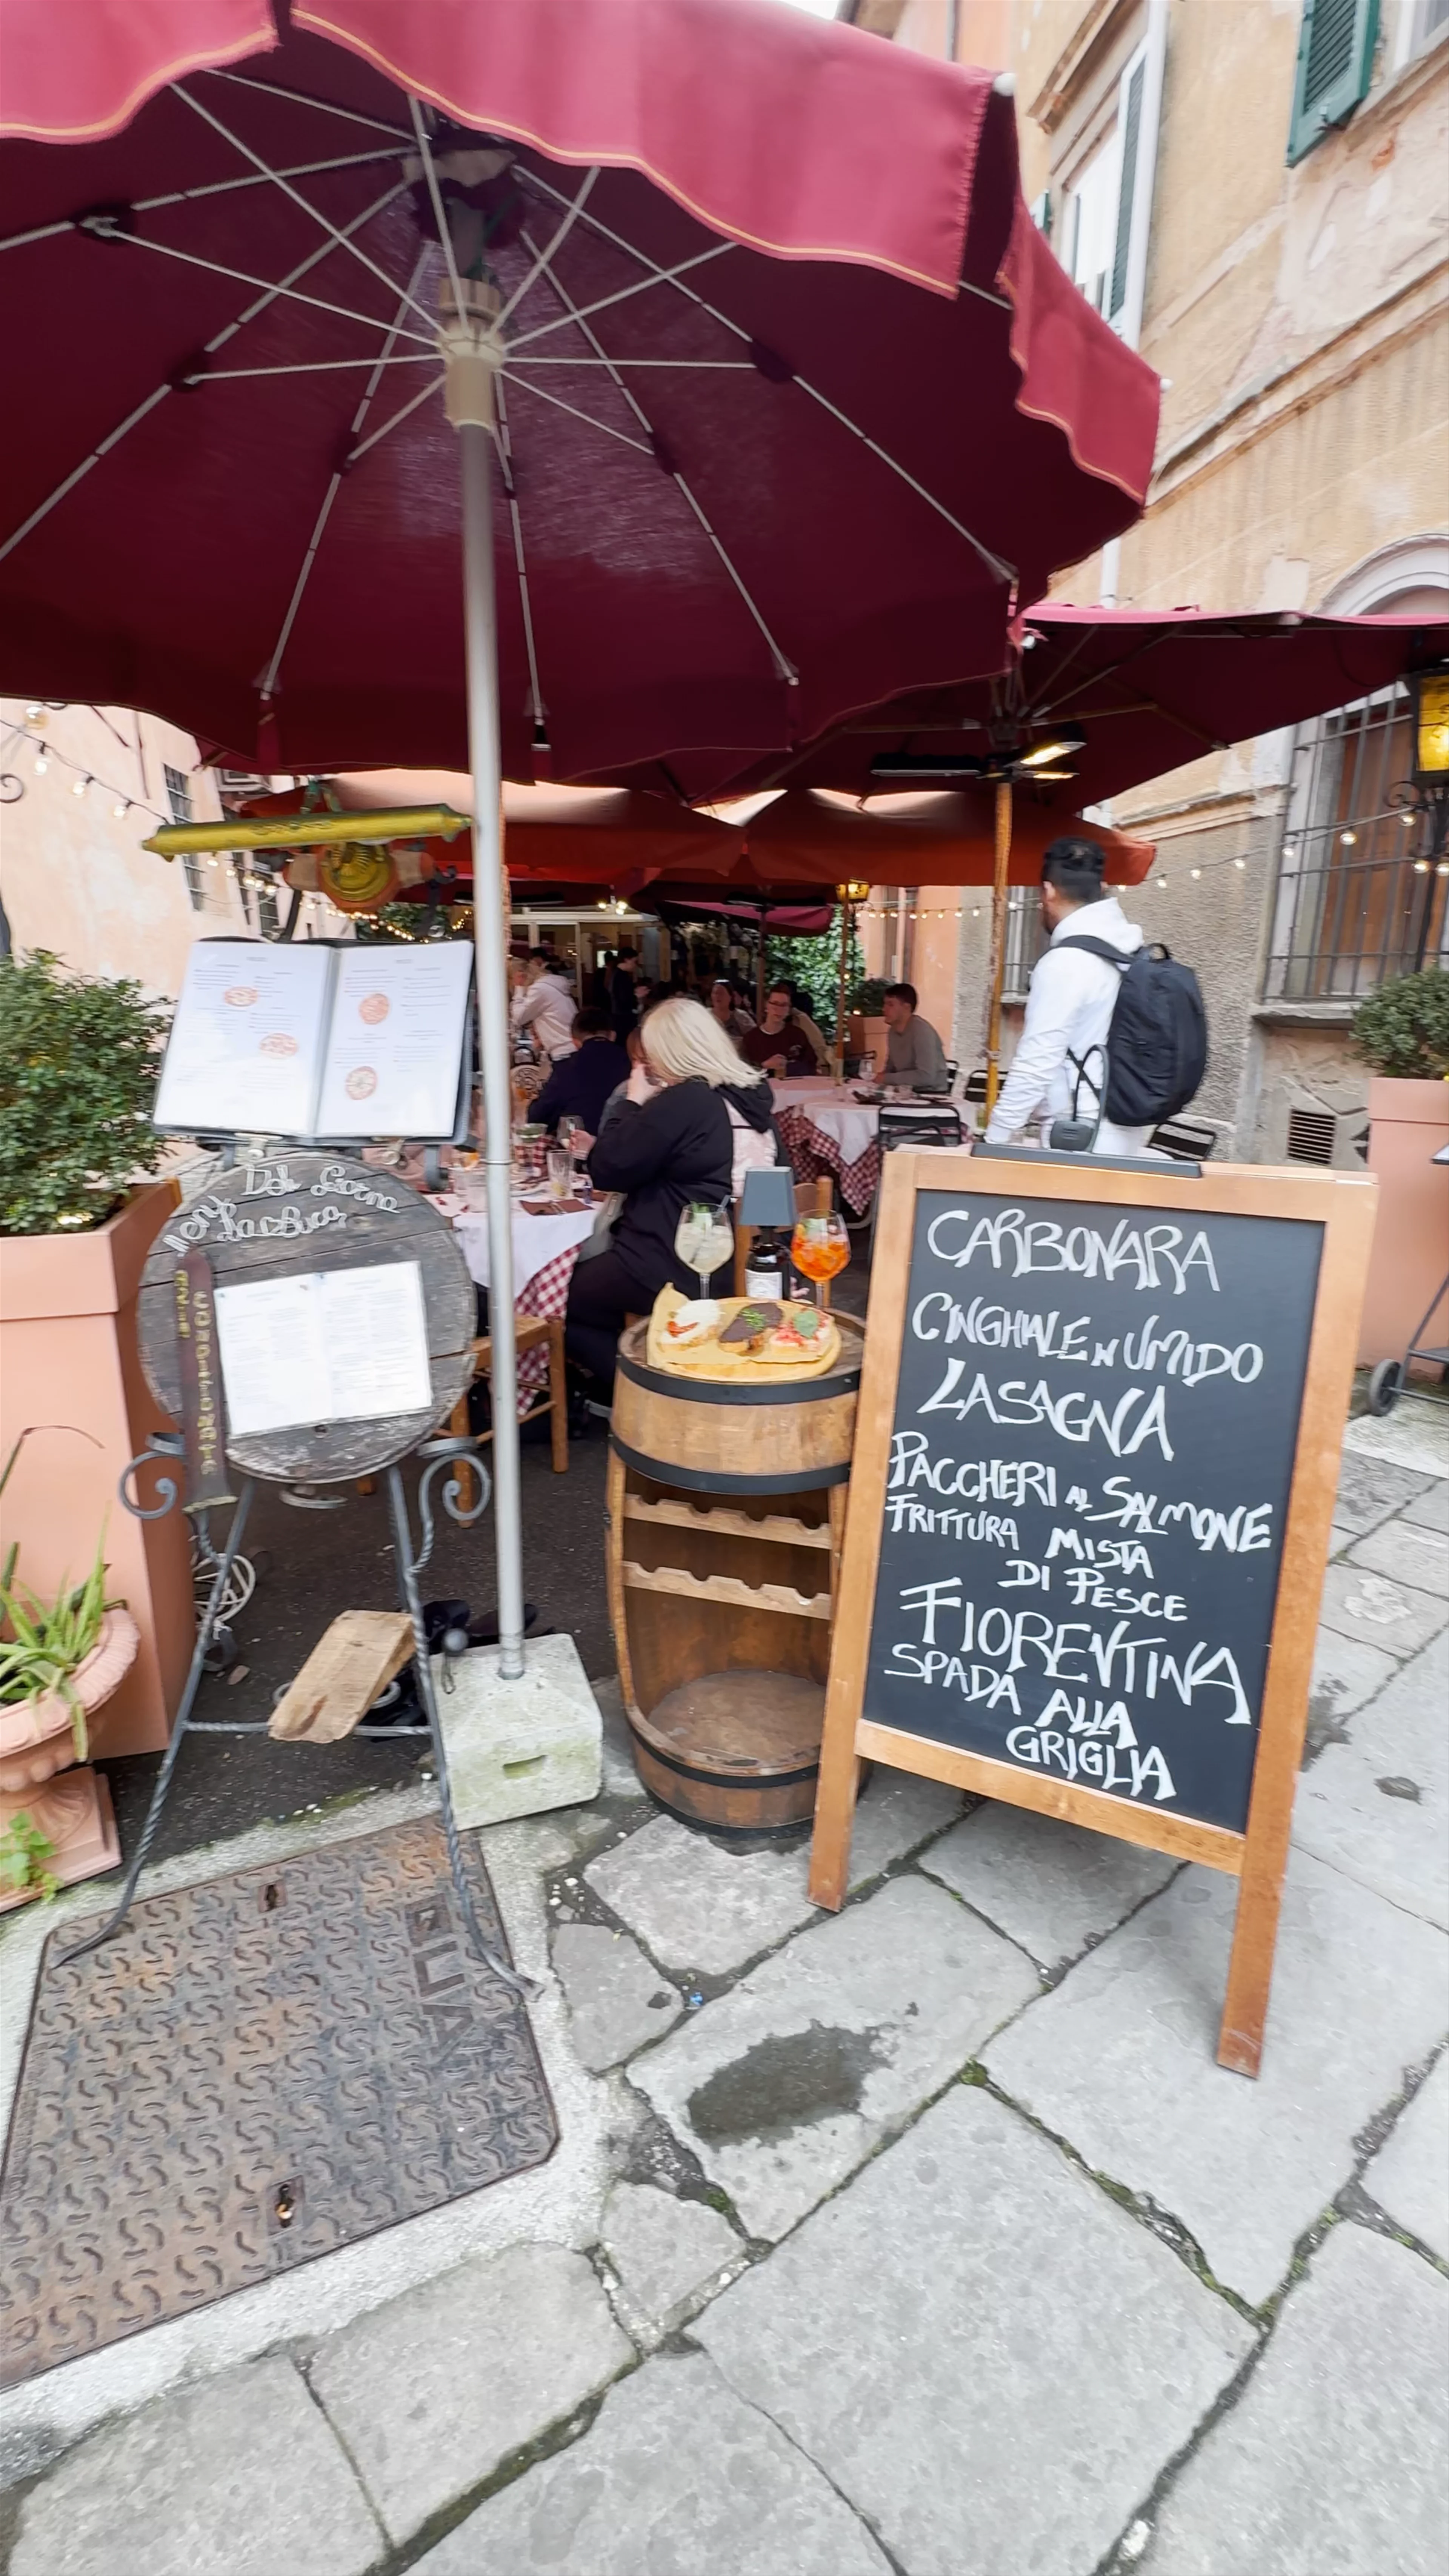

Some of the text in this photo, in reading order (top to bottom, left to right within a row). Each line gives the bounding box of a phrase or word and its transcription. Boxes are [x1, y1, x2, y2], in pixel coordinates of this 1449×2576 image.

[311, 1165, 401, 1213] Giorno
[927, 1208, 1220, 1295] CARBONARA
[1123, 1315, 1264, 1387] UMIDO
[916, 1357, 1174, 1462] LASAGNA
[887, 1430, 1056, 1508] PACCHERI
[1083, 1476, 1273, 1553] SALMONE
[886, 1493, 1154, 1579] FRITTURA MISTA
[997, 1560, 1188, 1621] DI PESCE
[900, 1576, 1251, 1725] FIORENTINA
[884, 1643, 1138, 1750] SPADA ALLA
[1006, 1726, 1177, 1801] GRIGLIA
